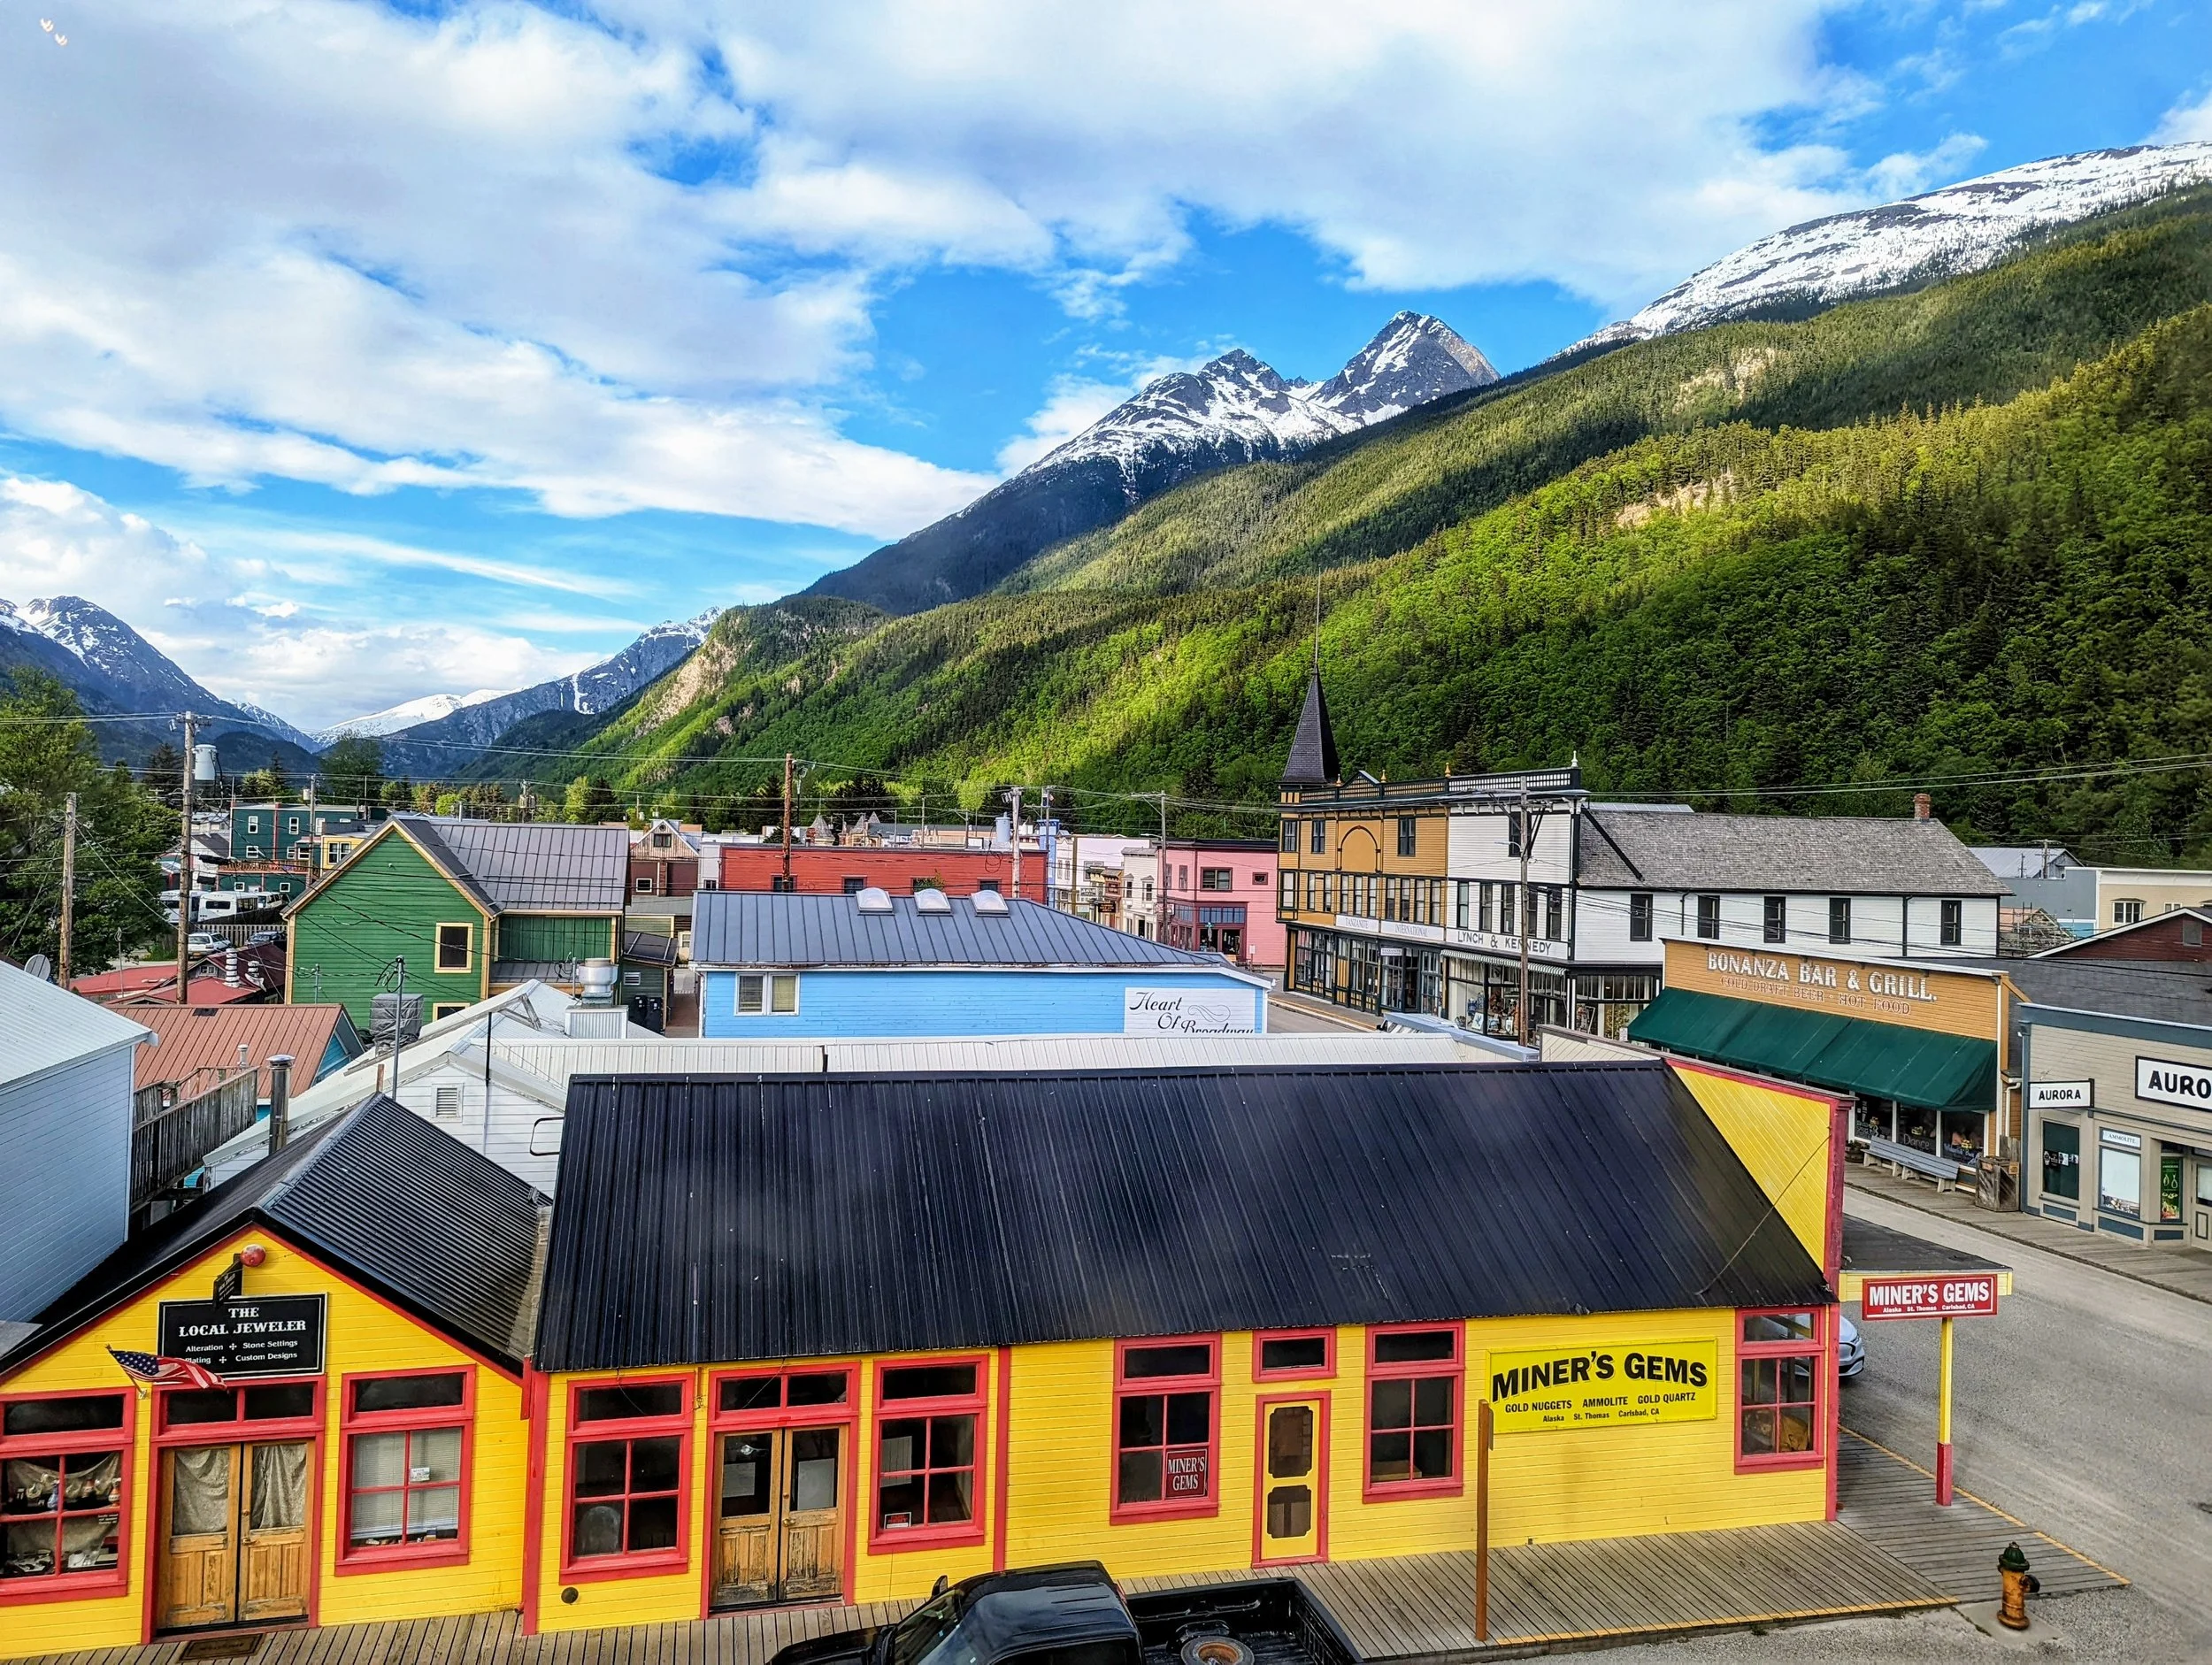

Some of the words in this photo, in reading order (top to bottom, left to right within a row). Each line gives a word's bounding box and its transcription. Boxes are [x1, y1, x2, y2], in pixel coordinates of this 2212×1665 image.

[1346, 918, 1369, 929] TANZANITE
[1395, 924, 1427, 937] INTERNATIONAL
[1458, 931, 1483, 944] LYNCH
[1491, 935, 1498, 948] &
[1708, 952, 1789, 980] BONANZA
[1798, 962, 1837, 987] BAR
[1847, 969, 1860, 991] &
[1129, 992, 1182, 1010] Heart
[1721, 976, 1748, 990] COLD
[1753, 981, 1787, 996] DRAFT
[1793, 987, 1824, 1002] BEER
[1839, 993, 1866, 1008] HOT
[1873, 998, 1911, 1015] FOOD
[1158, 1012, 1181, 1029] Of
[2039, 1089, 2081, 1101] AURORA
[1904, 1134, 1929, 1150] Dance
[2108, 1133, 2135, 1143] AMMOLITE
[1870, 1284, 1939, 1306] MINER'S
[1943, 1282, 1989, 1302] GEMS
[228, 1307, 259, 1318] THE
[179, 1324, 228, 1337] LOCAL
[233, 1320, 306, 1334] JEWELER
[186, 1344, 223, 1353] Alteration
[267, 1339, 298, 1348] Settings
[267, 1352, 297, 1361] Designs
[1492, 1351, 1615, 1403] MINER'S
[1624, 1352, 1708, 1388] GEMS
[1506, 1402, 1529, 1413] GOLD
[1532, 1400, 1572, 1411] NUGGETS
[1582, 1396, 1628, 1408] AMMOLITE
[1637, 1395, 1661, 1404] GOLD
[1663, 1393, 1695, 1404] QUARTZ
[1618, 1409, 1648, 1418] Carlsbad,
[1168, 1456, 1204, 1474] MINER'S
[1173, 1474, 1198, 1491] GEMS
